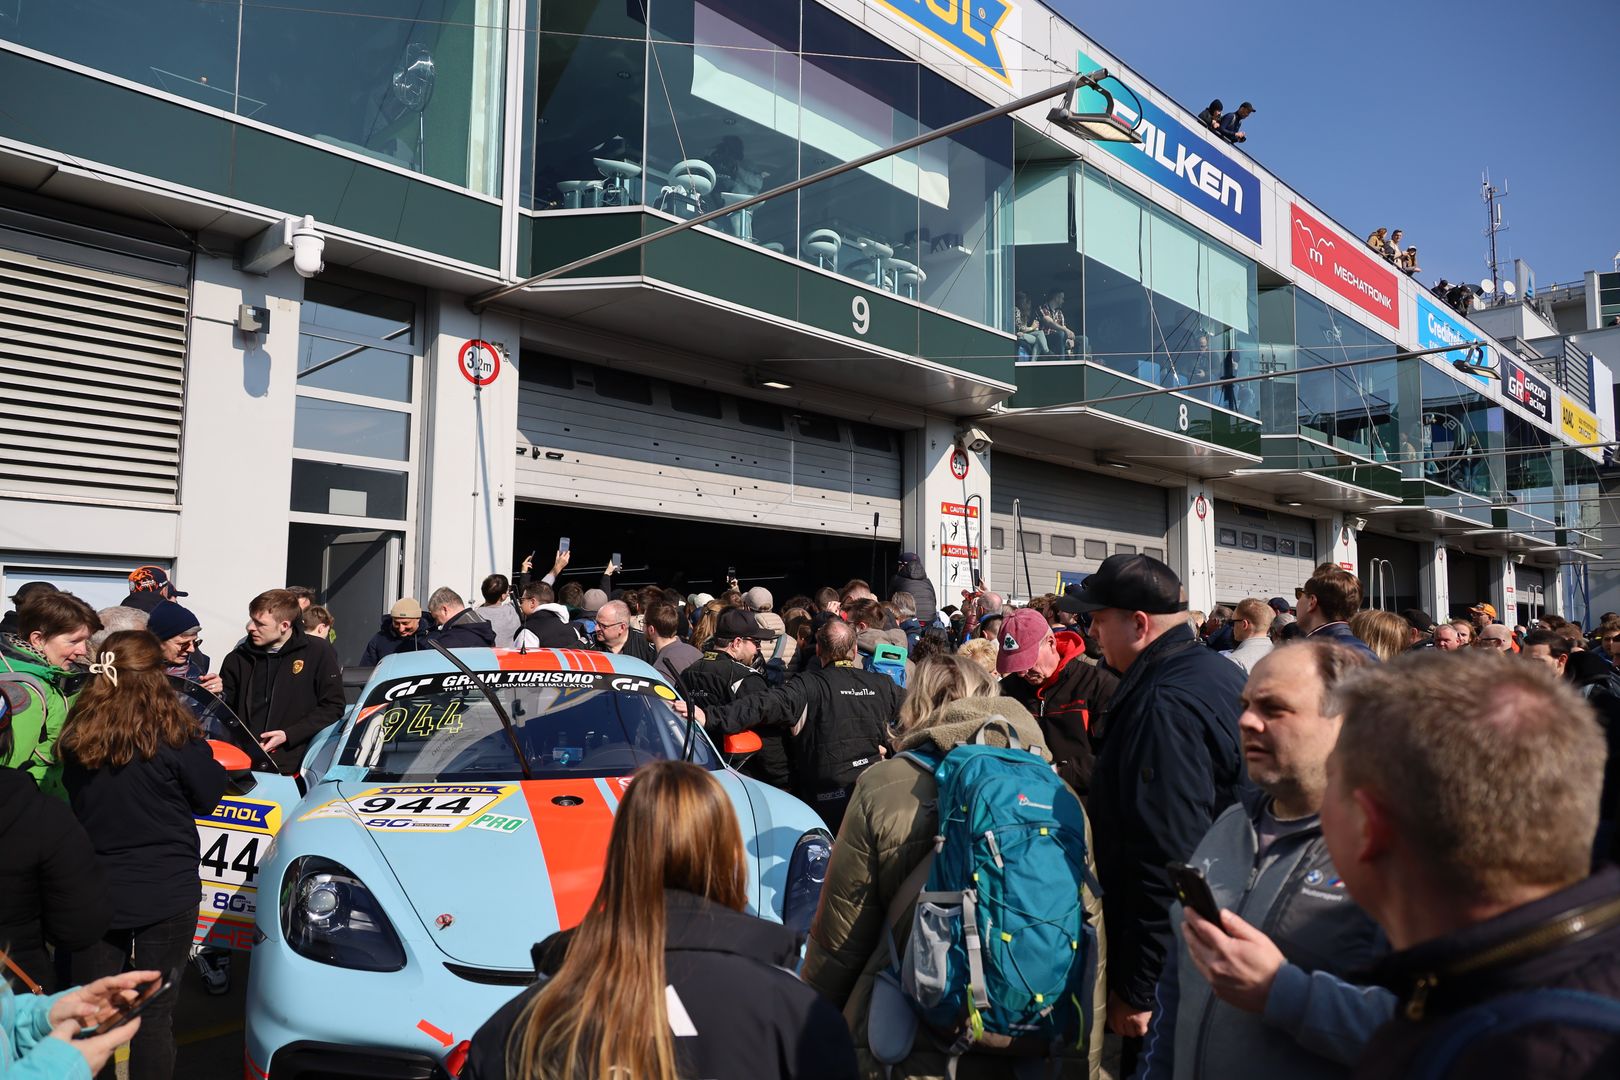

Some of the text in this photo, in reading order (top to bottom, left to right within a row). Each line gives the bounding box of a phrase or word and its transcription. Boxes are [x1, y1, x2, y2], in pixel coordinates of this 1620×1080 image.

[1334, 262, 1392, 310] MECHATRONIK
[852, 296, 870, 335] 9
[1524, 377, 1547, 400] GAZOO
[1179, 403, 1188, 431] 8
[1524, 391, 1546, 417] Racing
[382, 700, 463, 743] 944
[387, 785, 492, 794] RAVENOL
[358, 796, 473, 815] 944
[474, 814, 523, 831] PRO
[200, 833, 260, 883] 44
